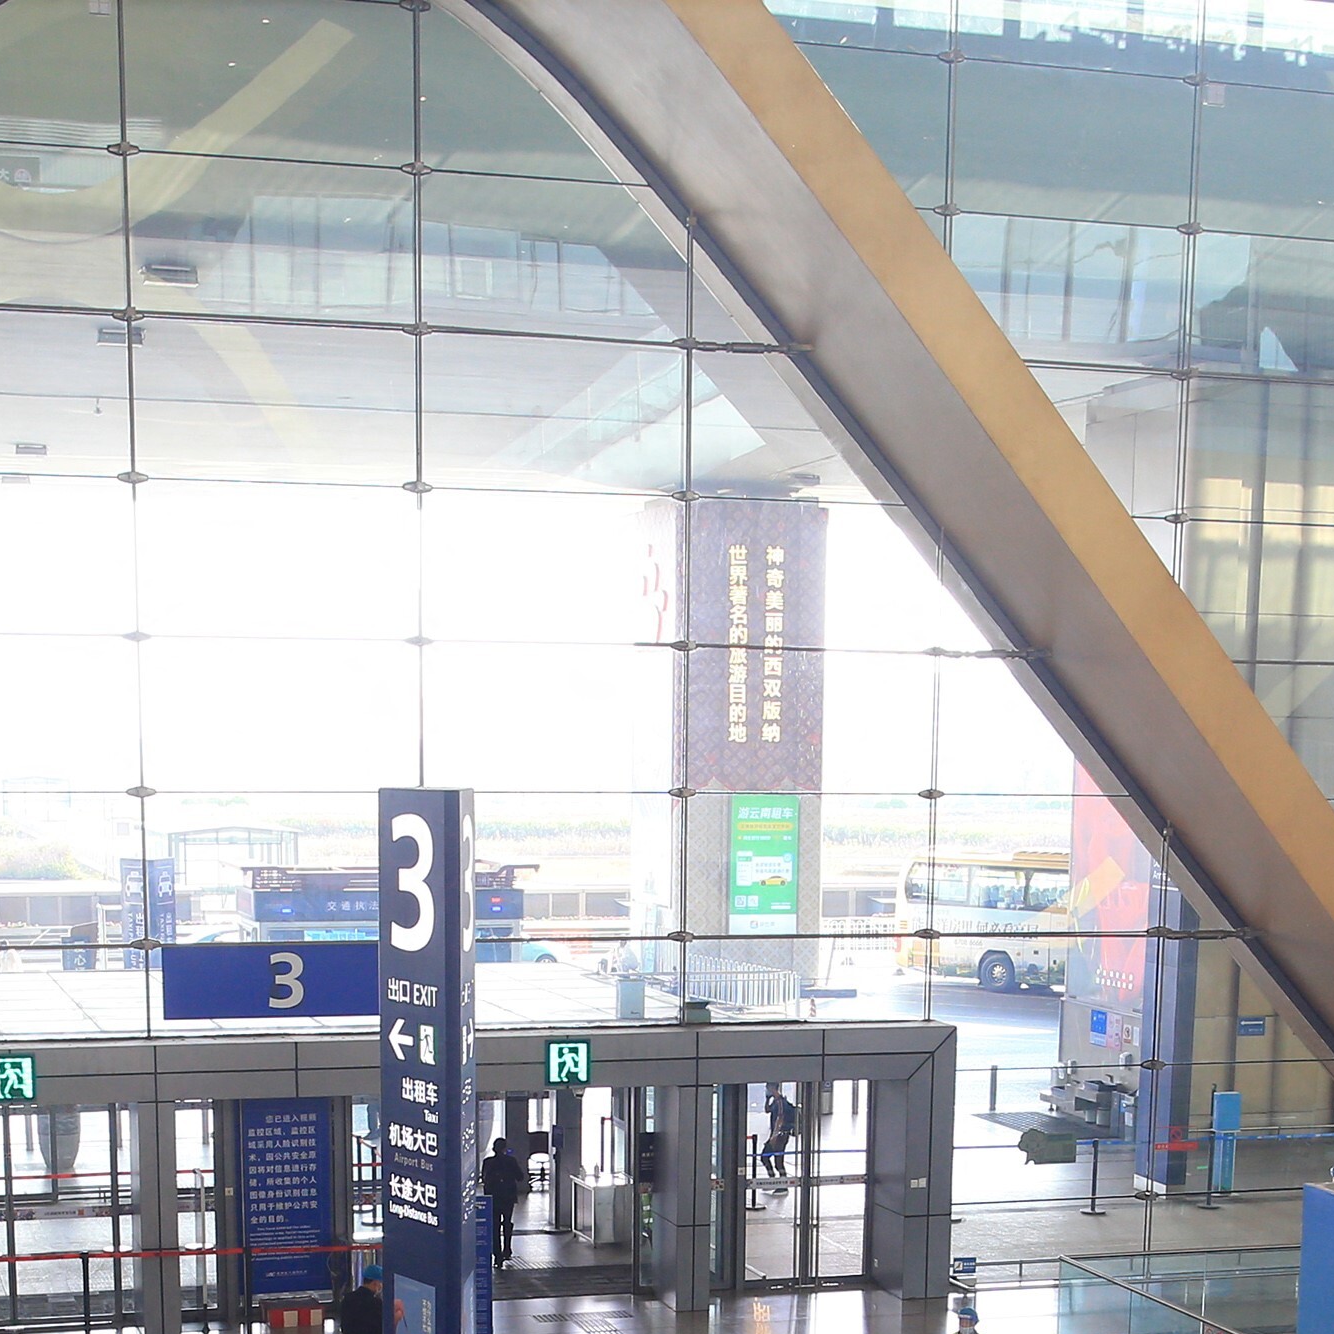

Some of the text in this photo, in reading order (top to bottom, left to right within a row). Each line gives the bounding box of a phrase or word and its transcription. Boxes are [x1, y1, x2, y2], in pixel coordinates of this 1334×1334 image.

[728, 545, 748, 743] 世界著名的旅游目的地
[761, 546, 784, 743] 神奇美丽的西双版纳
[738, 806, 794, 820] 游云南租车
[391, 813, 435, 952] 3
[268, 952, 305, 1010] 3
[388, 977, 410, 1003] 出口
[413, 984, 438, 1007] EXIT
[401, 1077, 438, 1106] 出租车
[423, 1108, 439, 1124] Taxi
[389, 1122, 438, 1156] 机场大巴
[394, 1152, 434, 1171] Airport Bus
[389, 1174, 437, 1208] 长途大巴
[389, 1200, 439, 1227] Long-Distance Bus
